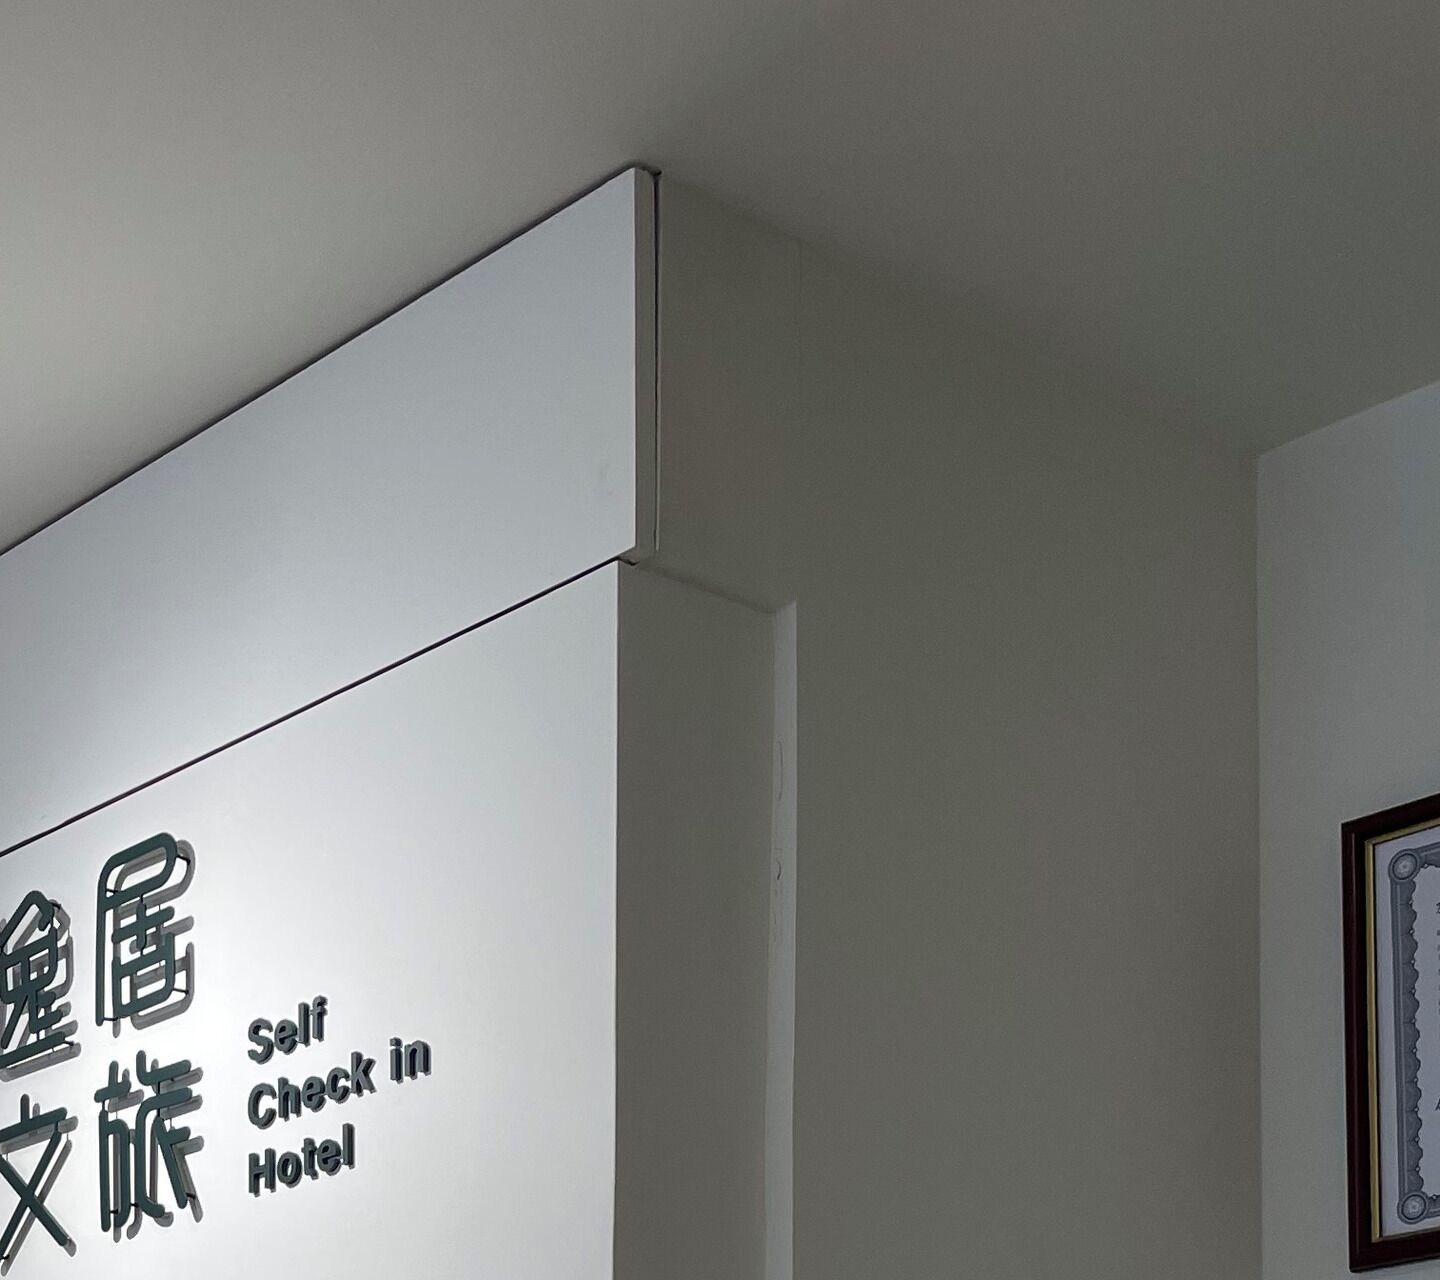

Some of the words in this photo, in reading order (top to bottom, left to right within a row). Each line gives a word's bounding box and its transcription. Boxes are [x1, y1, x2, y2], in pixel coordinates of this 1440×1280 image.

[248, 995, 328, 1064] Self
[248, 1051, 377, 1130] Check
[389, 1037, 432, 1084] in
[248, 1123, 355, 1197] Hotel
